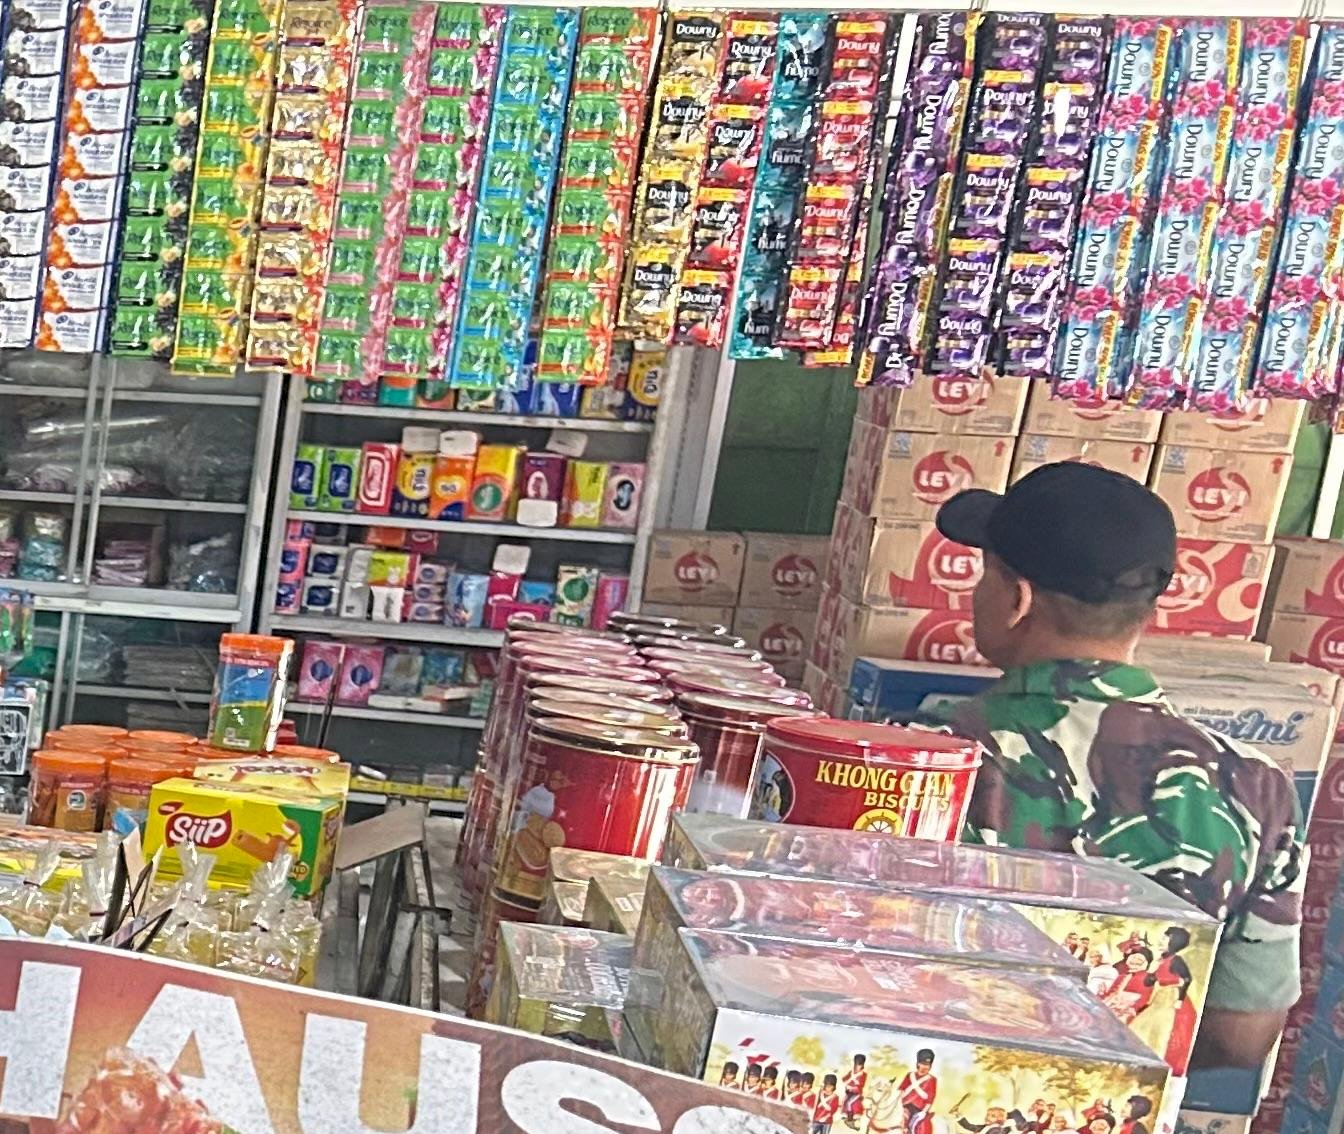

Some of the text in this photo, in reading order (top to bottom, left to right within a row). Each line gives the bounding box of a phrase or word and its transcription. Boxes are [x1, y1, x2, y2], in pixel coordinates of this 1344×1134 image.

[676, 23, 717, 40] Downy
[1058, 23, 1102, 38] Downy
[1187, 31, 1213, 84] Downy
[949, 257, 994, 274] Downy
[1079, 232, 1107, 288] Downy
[1217, 243, 1245, 299] Downy
[1290, 222, 1316, 278] Downy
[683, 290, 722, 307] Downy
[1146, 315, 1173, 371] Downy
[815, 758, 897, 792] KHONG
